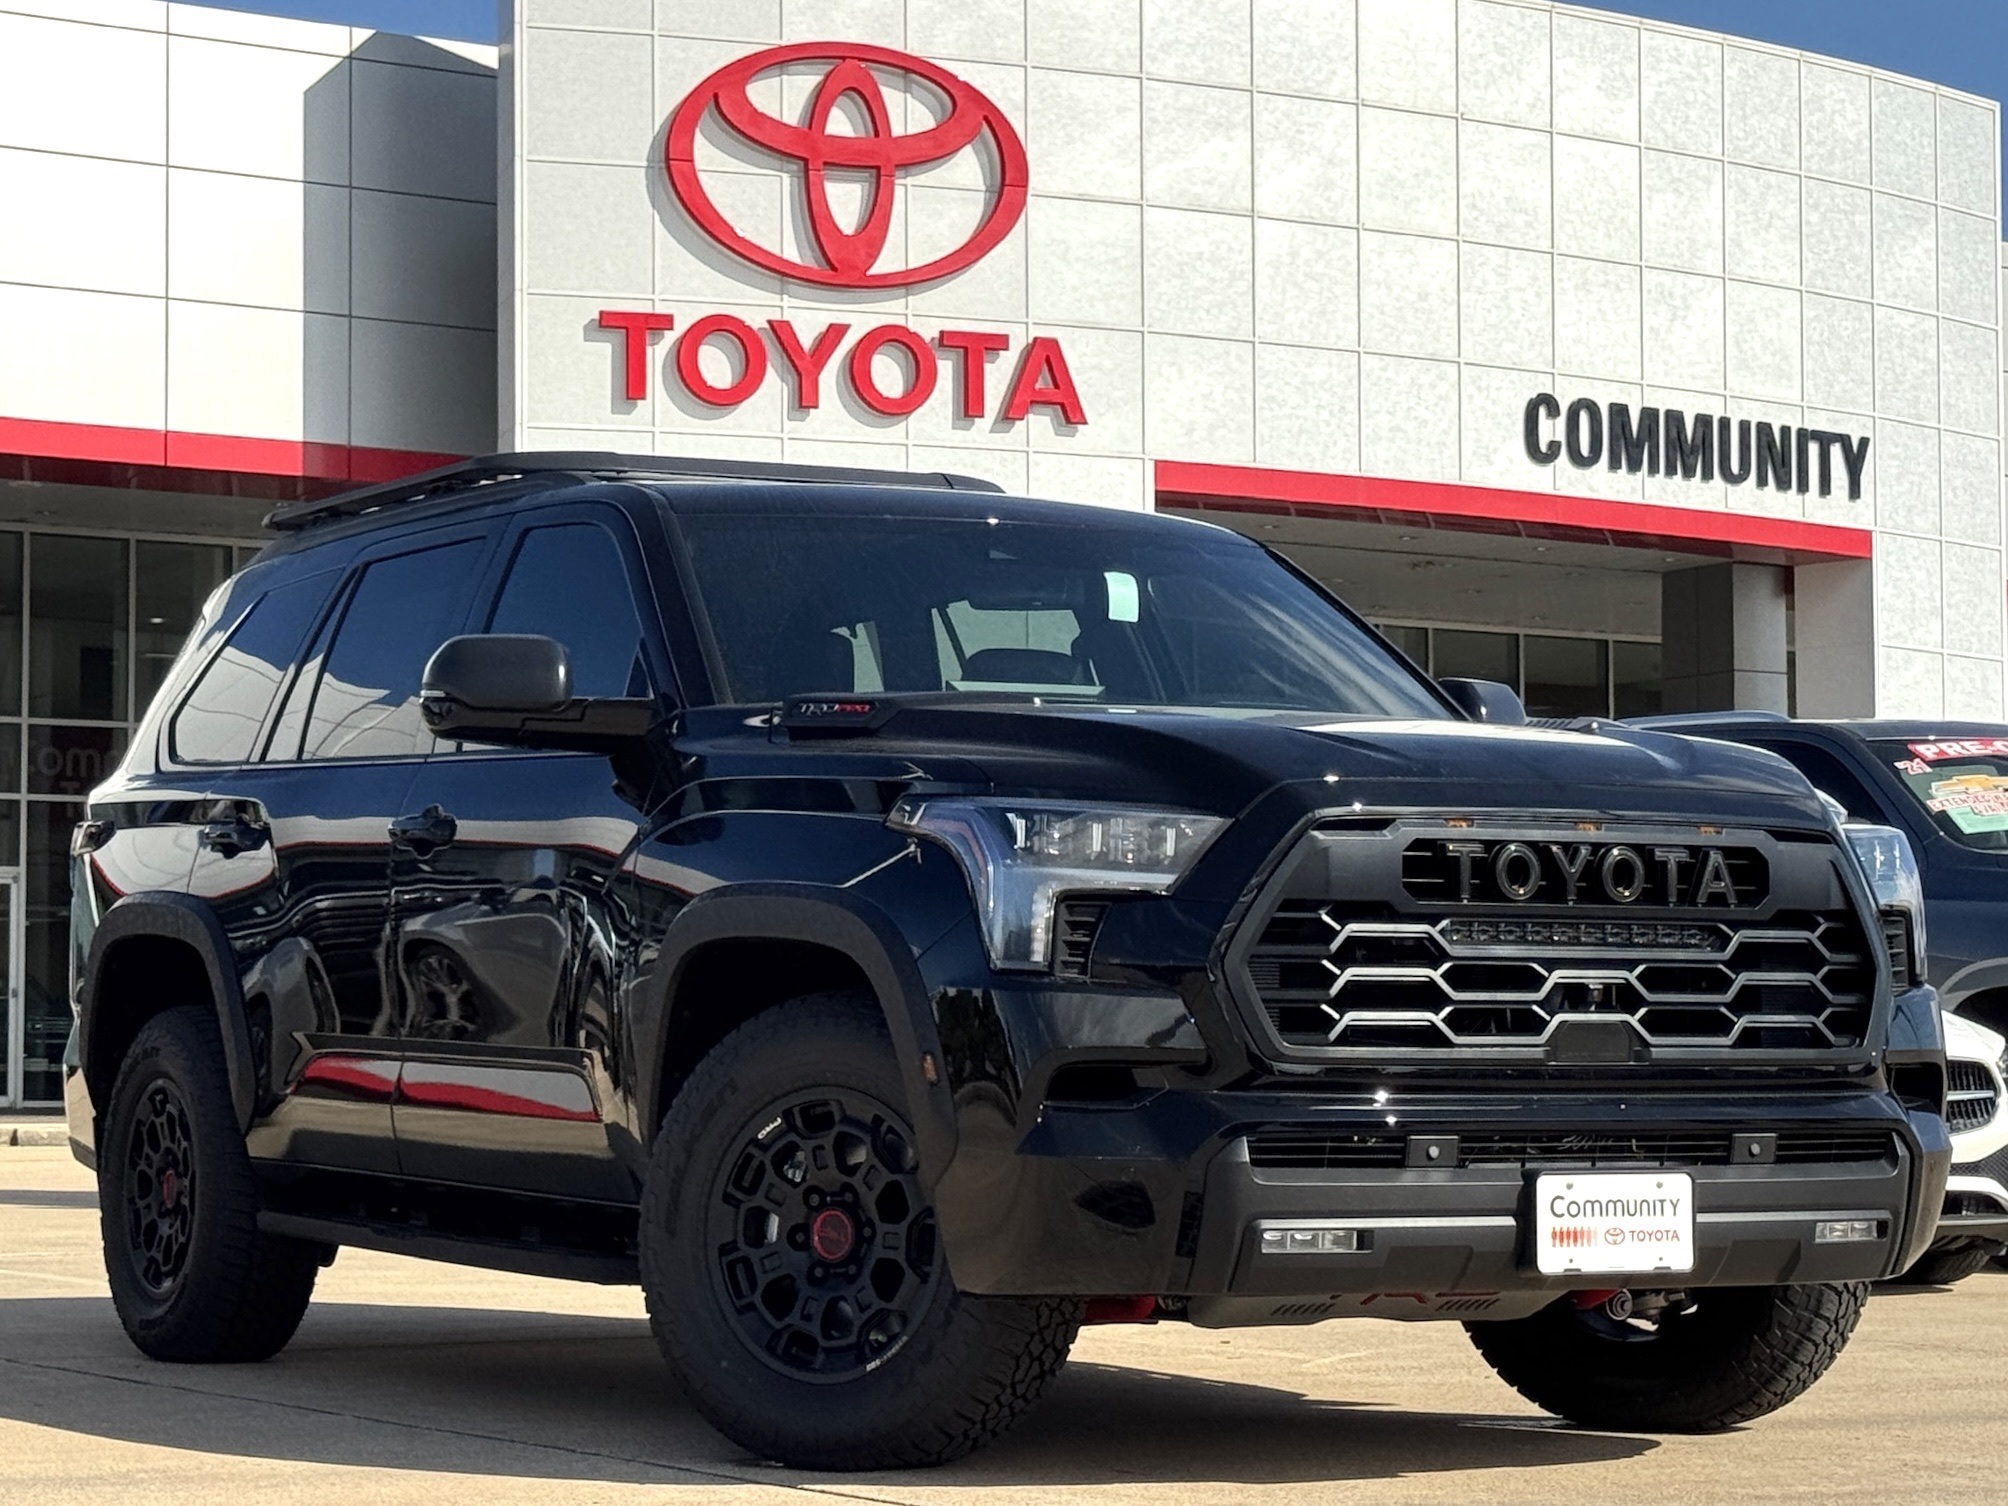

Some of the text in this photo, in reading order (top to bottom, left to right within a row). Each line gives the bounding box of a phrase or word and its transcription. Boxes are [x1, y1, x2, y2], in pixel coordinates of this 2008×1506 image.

[599, 310, 1088, 426] TOYOTA
[1524, 392, 1871, 502] COMMUNITY
[1444, 841, 1738, 907] TOYOTA
[1629, 1230, 1681, 1243] TOYOTA
